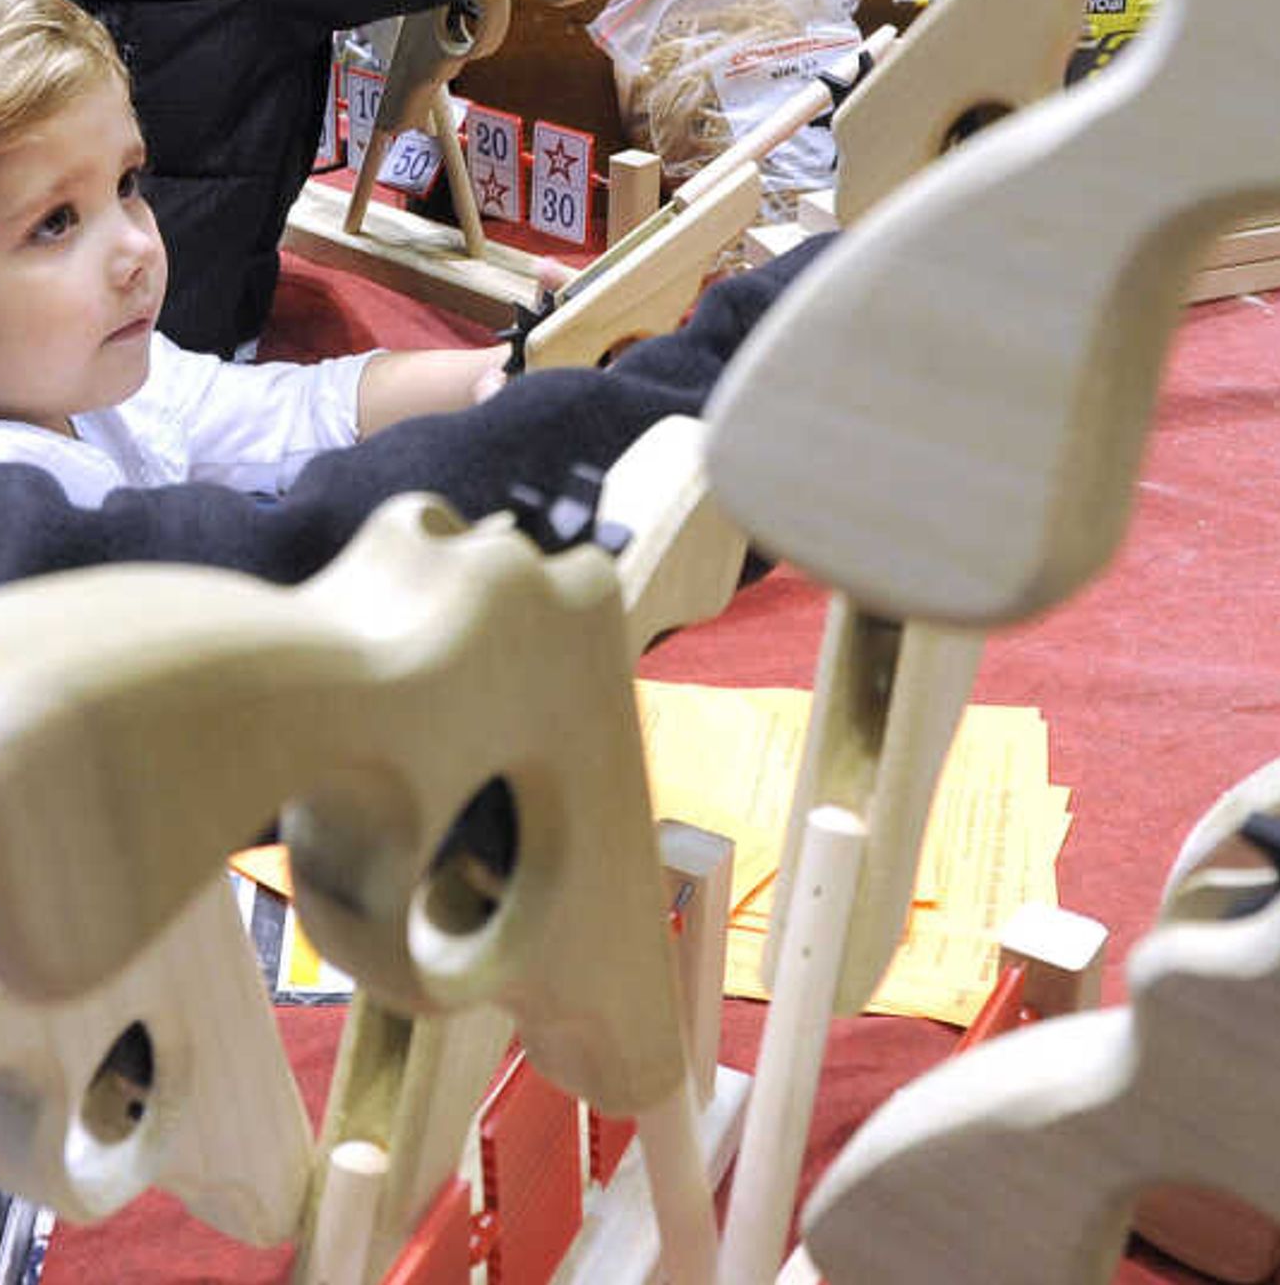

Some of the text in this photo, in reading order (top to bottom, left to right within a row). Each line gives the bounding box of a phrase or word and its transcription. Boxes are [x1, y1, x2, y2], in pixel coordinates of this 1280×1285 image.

[476, 122, 507, 161] 20
[394, 145, 431, 181] 50
[543, 188, 575, 228] 30
